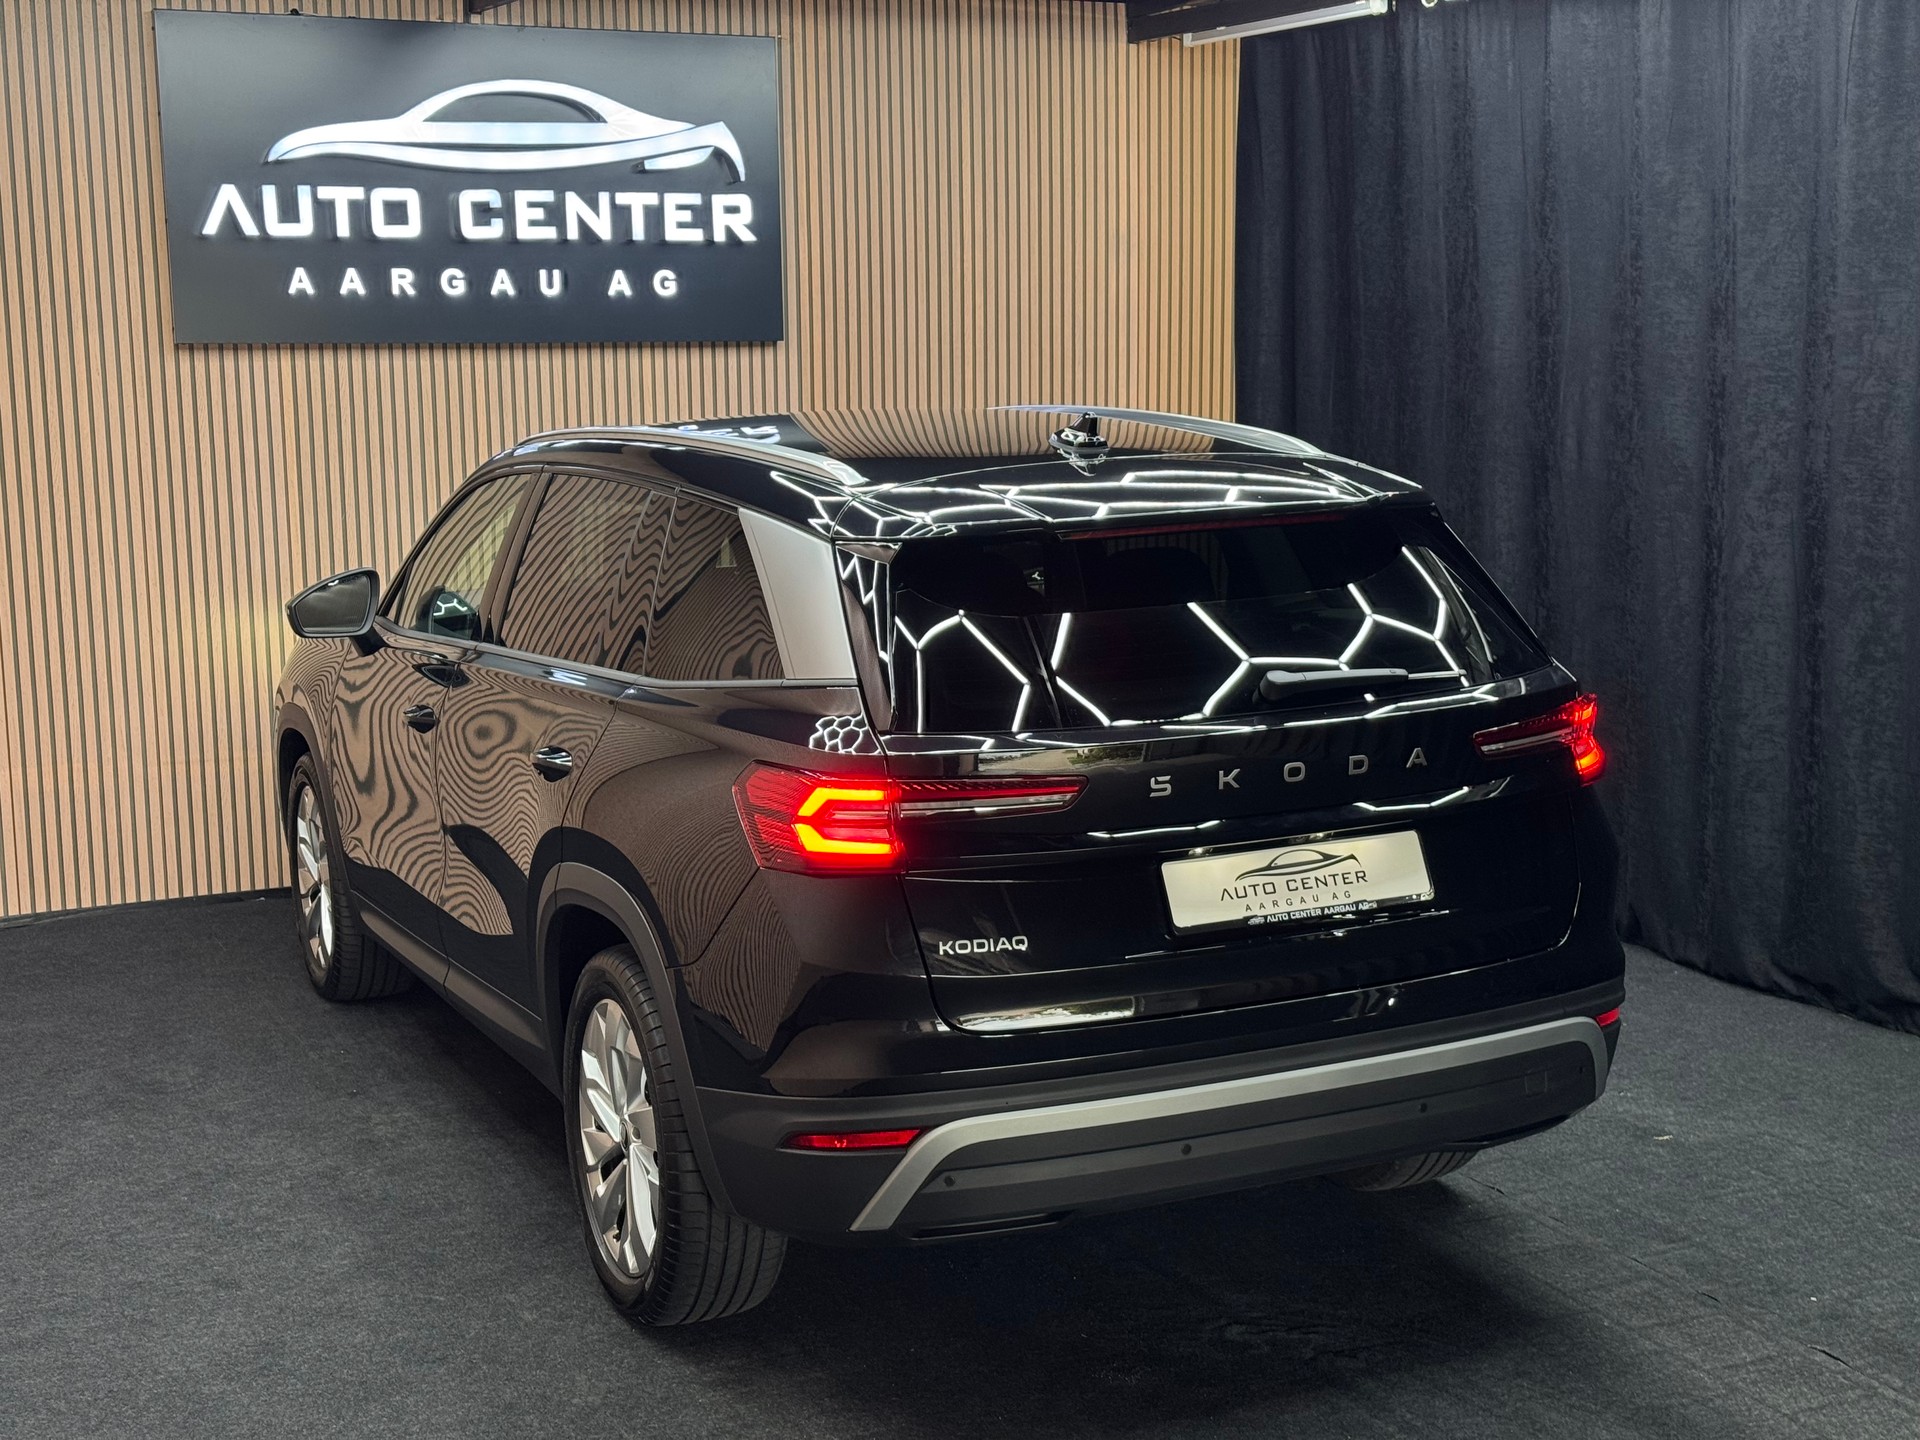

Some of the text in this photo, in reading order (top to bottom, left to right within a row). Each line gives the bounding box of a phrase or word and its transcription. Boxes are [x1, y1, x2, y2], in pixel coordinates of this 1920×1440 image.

[202, 183, 757, 242] AUTO CENTER
[288, 267, 678, 297] AARGAU AG
[1220, 870, 1369, 902] AUTO CENTER
[1245, 890, 1351, 912] AARGAU AG
[1266, 913, 1289, 923] AUTO
[1290, 907, 1322, 919] CENTER
[1323, 902, 1357, 915] AARGAU
[938, 935, 1028, 956] KODIAQ
